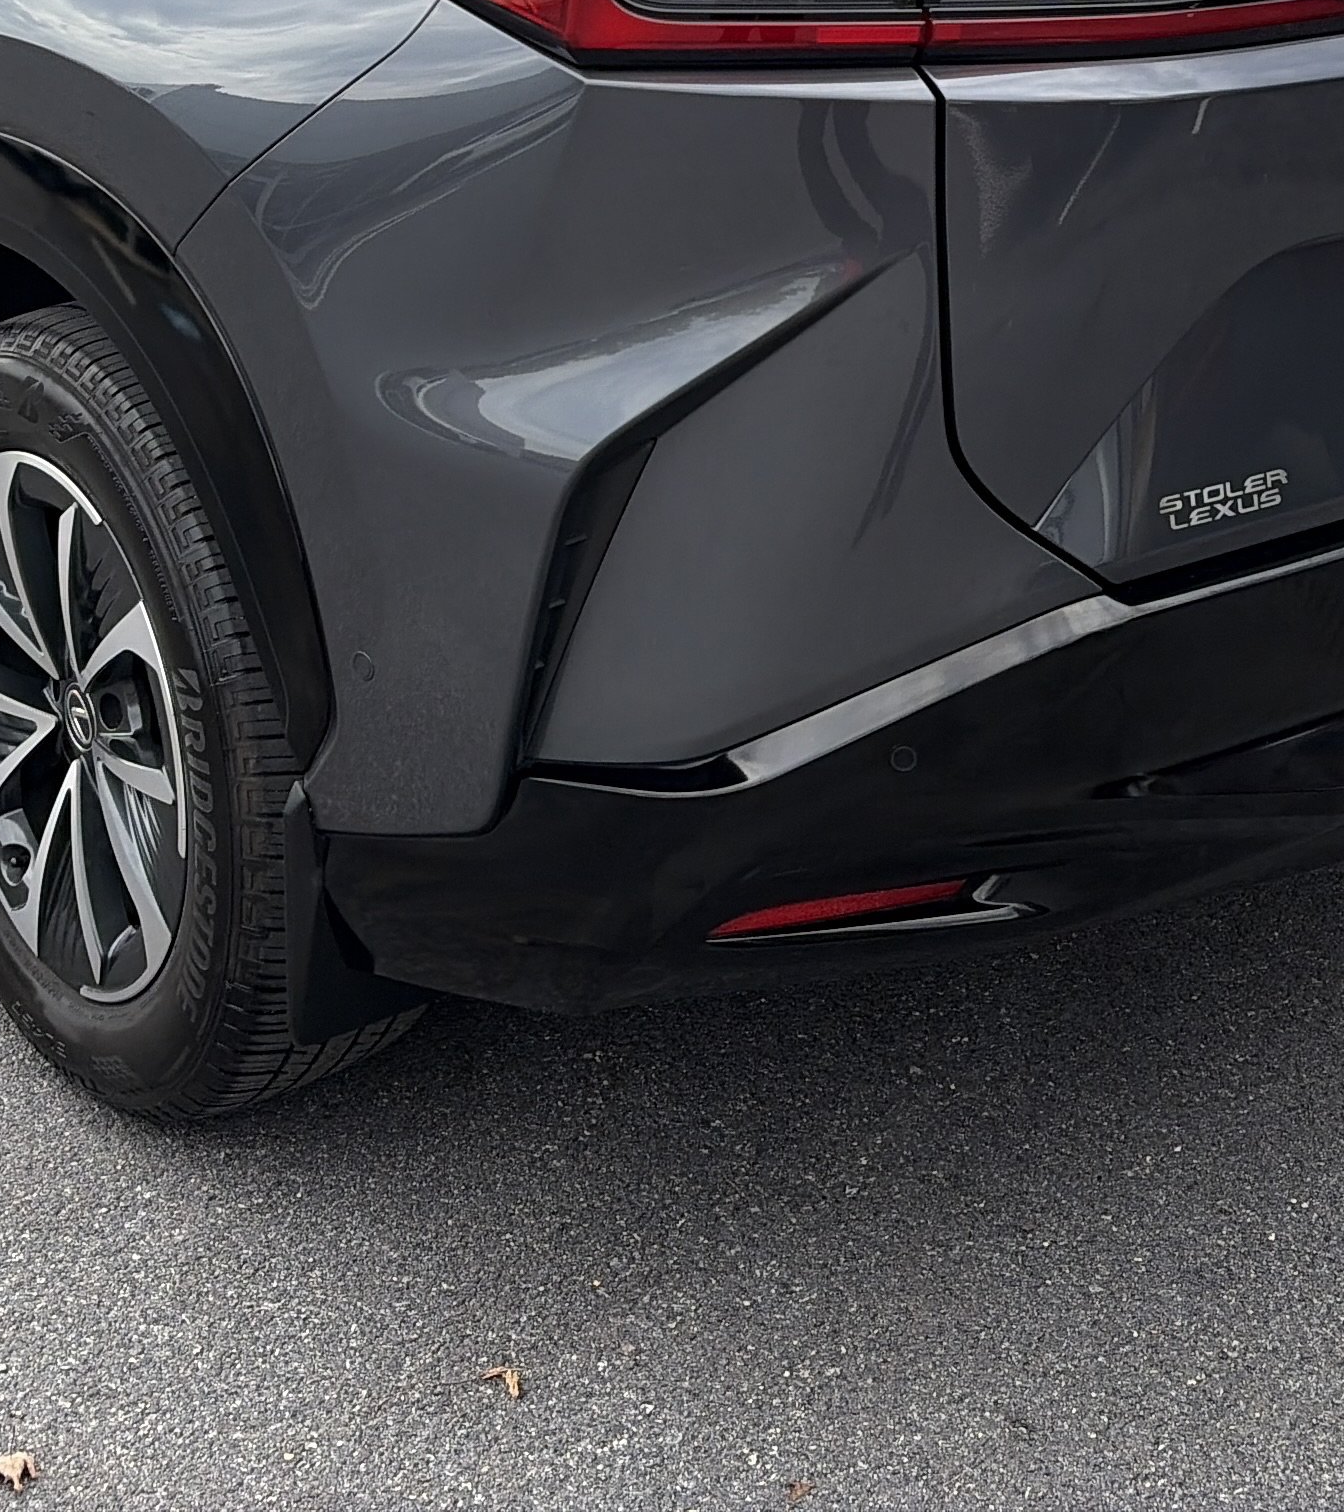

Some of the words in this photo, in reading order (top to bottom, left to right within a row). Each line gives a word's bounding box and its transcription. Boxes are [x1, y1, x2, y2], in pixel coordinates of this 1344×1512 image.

[1159, 468, 1289, 515] STOLER
[1169, 488, 1282, 530] LEXUS
[173, 667, 218, 1024] BRIDGESTONE
